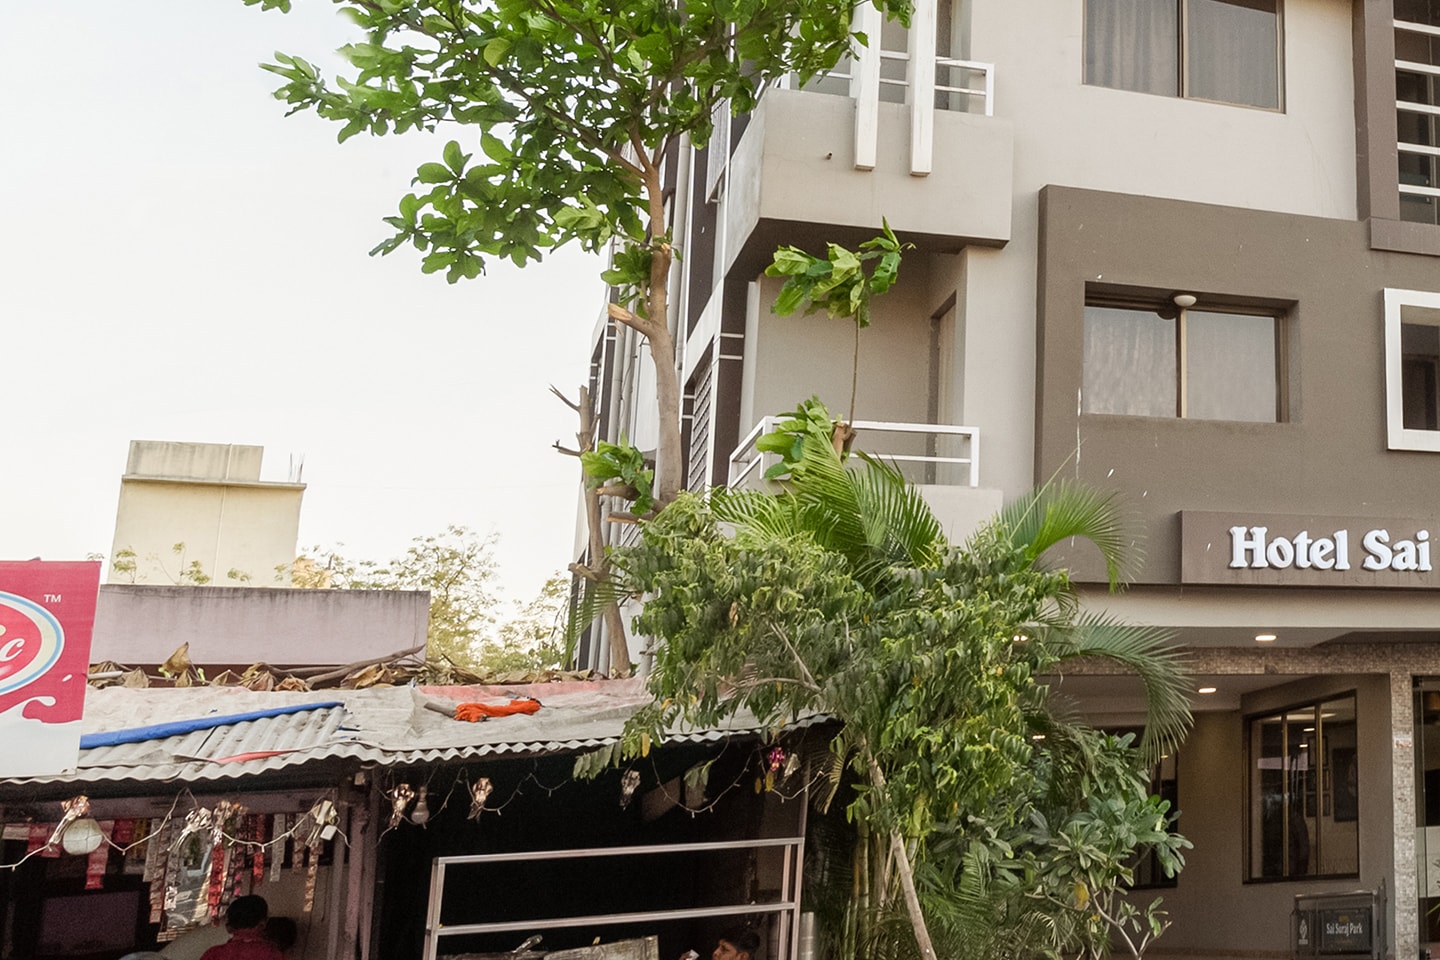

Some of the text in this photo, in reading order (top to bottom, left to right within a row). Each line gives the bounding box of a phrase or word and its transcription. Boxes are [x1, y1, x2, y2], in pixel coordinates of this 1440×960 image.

[1229, 526, 1351, 570] Hotel
[1362, 529, 1432, 573] Sai
[44, 594, 62, 603] TM
[1349, 922, 1363, 934] Park
